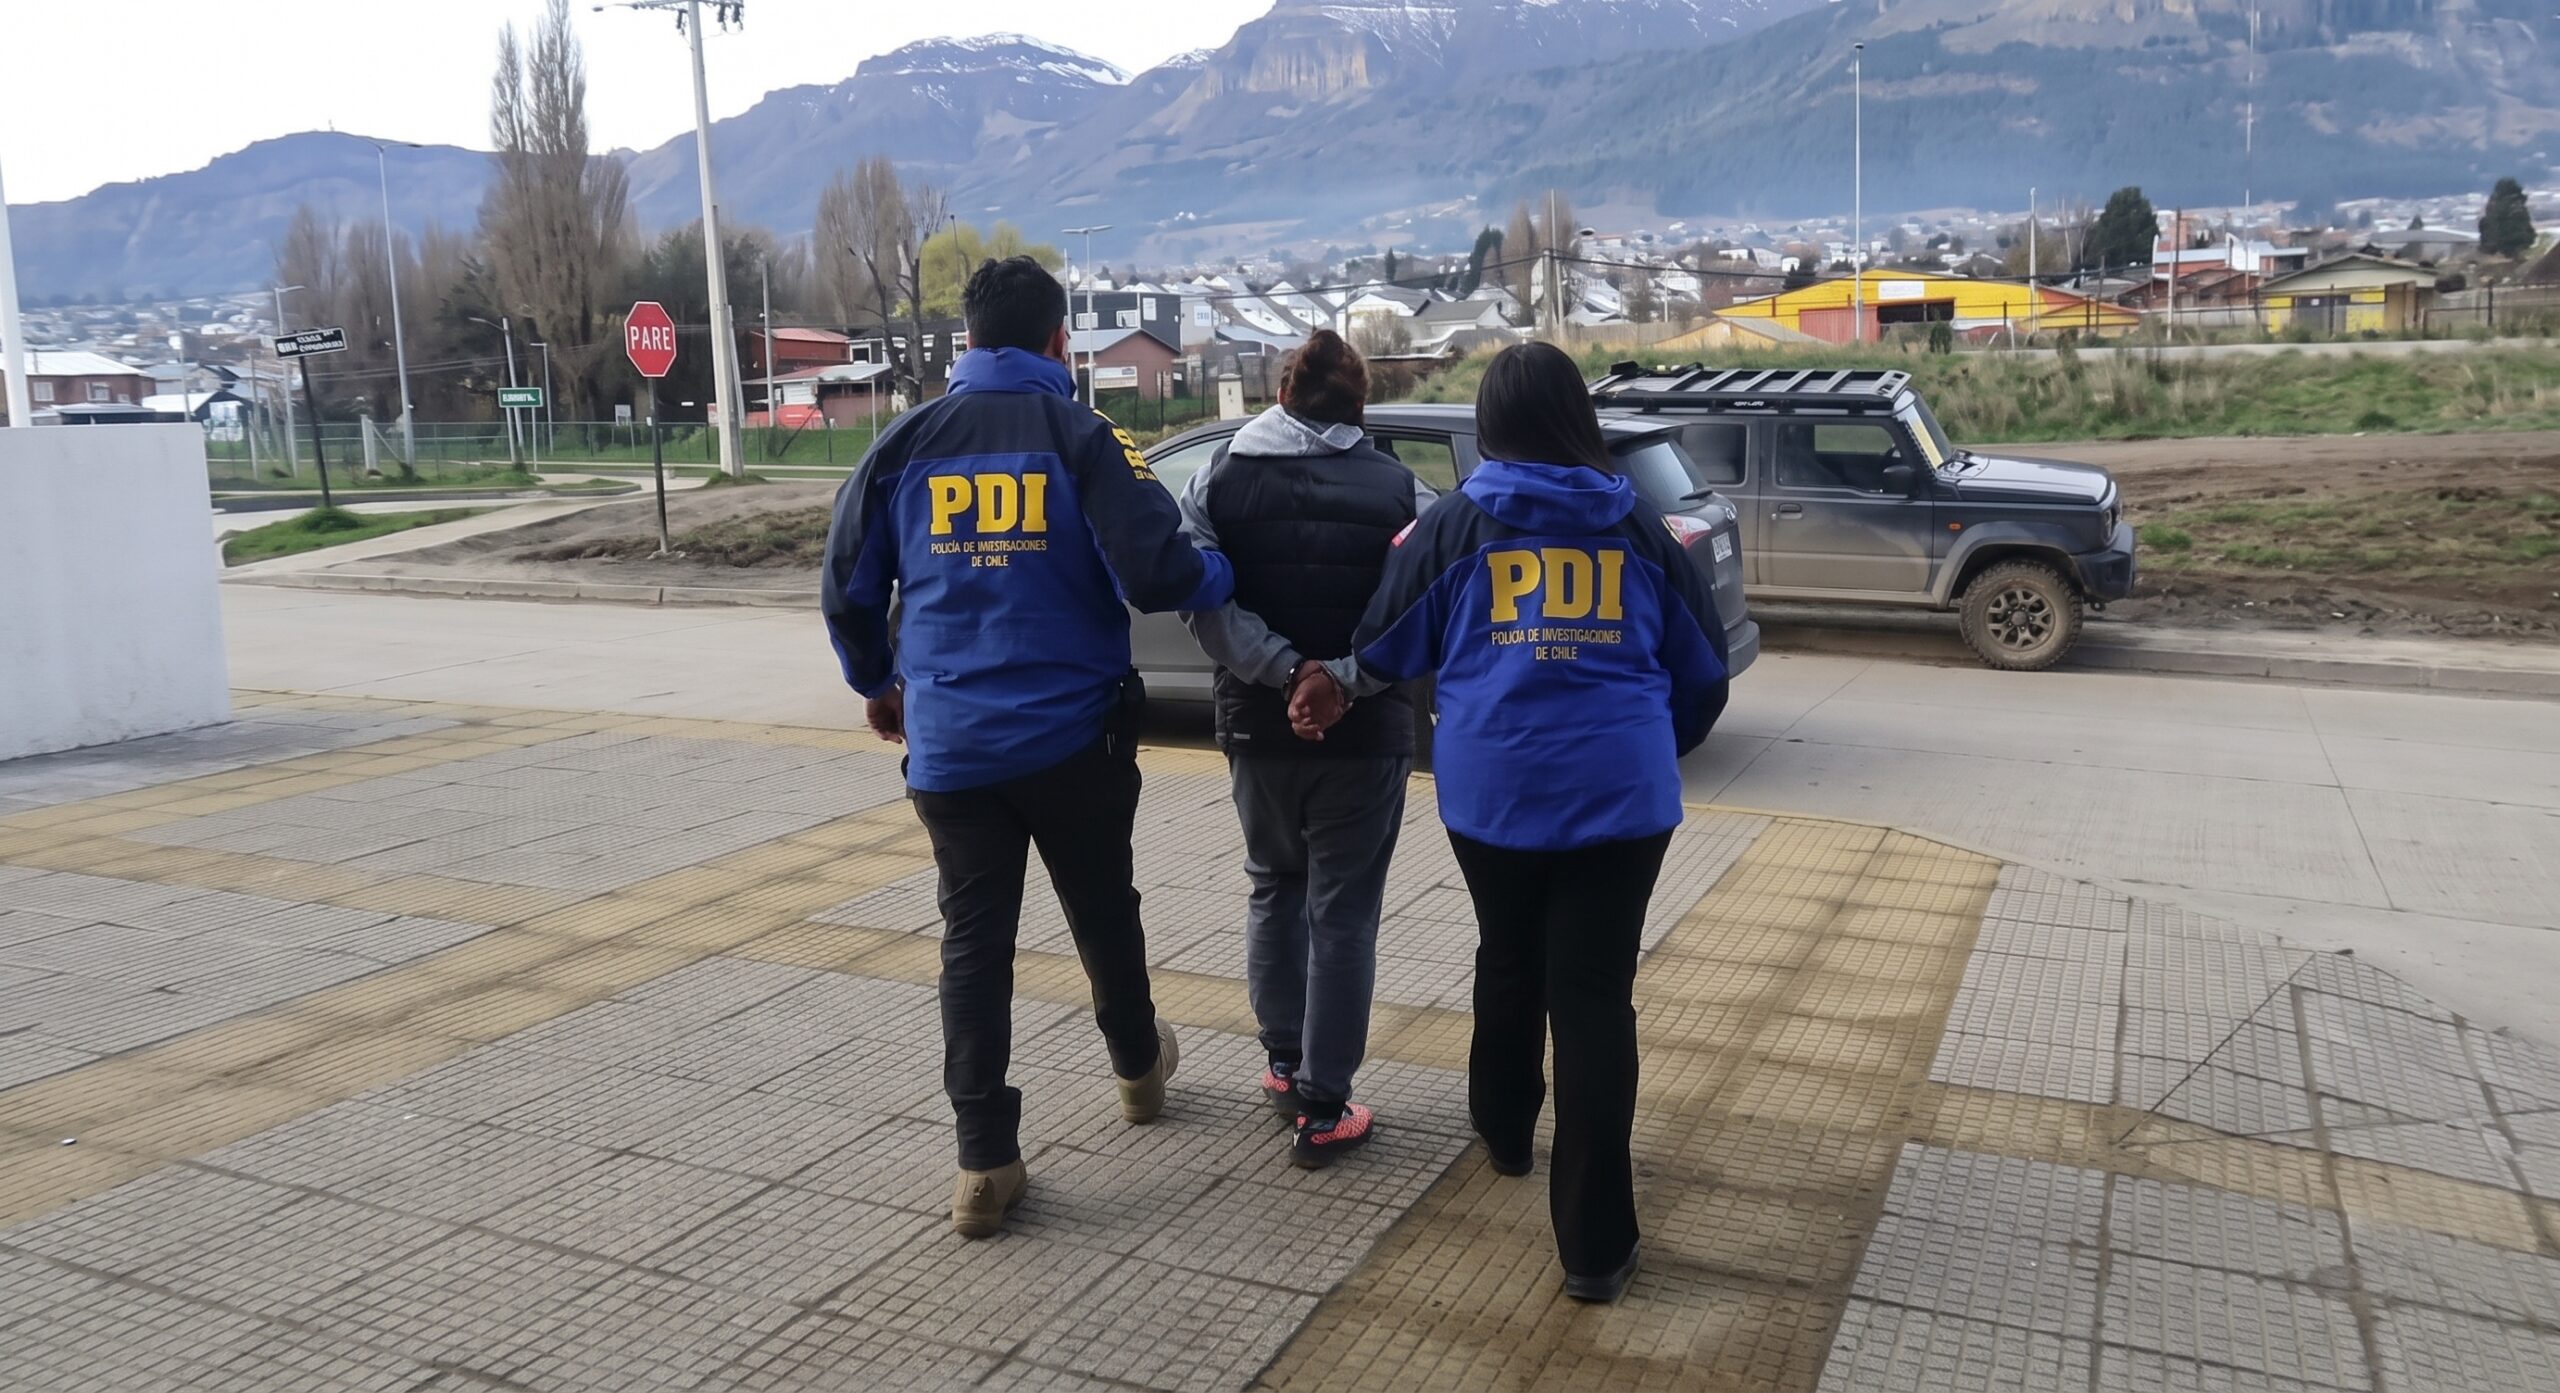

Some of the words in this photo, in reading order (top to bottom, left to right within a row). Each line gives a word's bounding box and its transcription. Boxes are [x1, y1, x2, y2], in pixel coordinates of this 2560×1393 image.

[630, 326, 672, 351] PARE
[928, 473, 1047, 535] PDI
[963, 541, 975, 552] DE
[971, 556, 982, 567] DE
[985, 555, 1008, 566] CHILE
[1487, 547, 1625, 623] PDI
[1528, 628, 1539, 642] DE
[1542, 628, 1622, 644] INVESTIGACIONES
[1536, 647, 1548, 660] DE
[1552, 646, 1577, 660] CHILE
